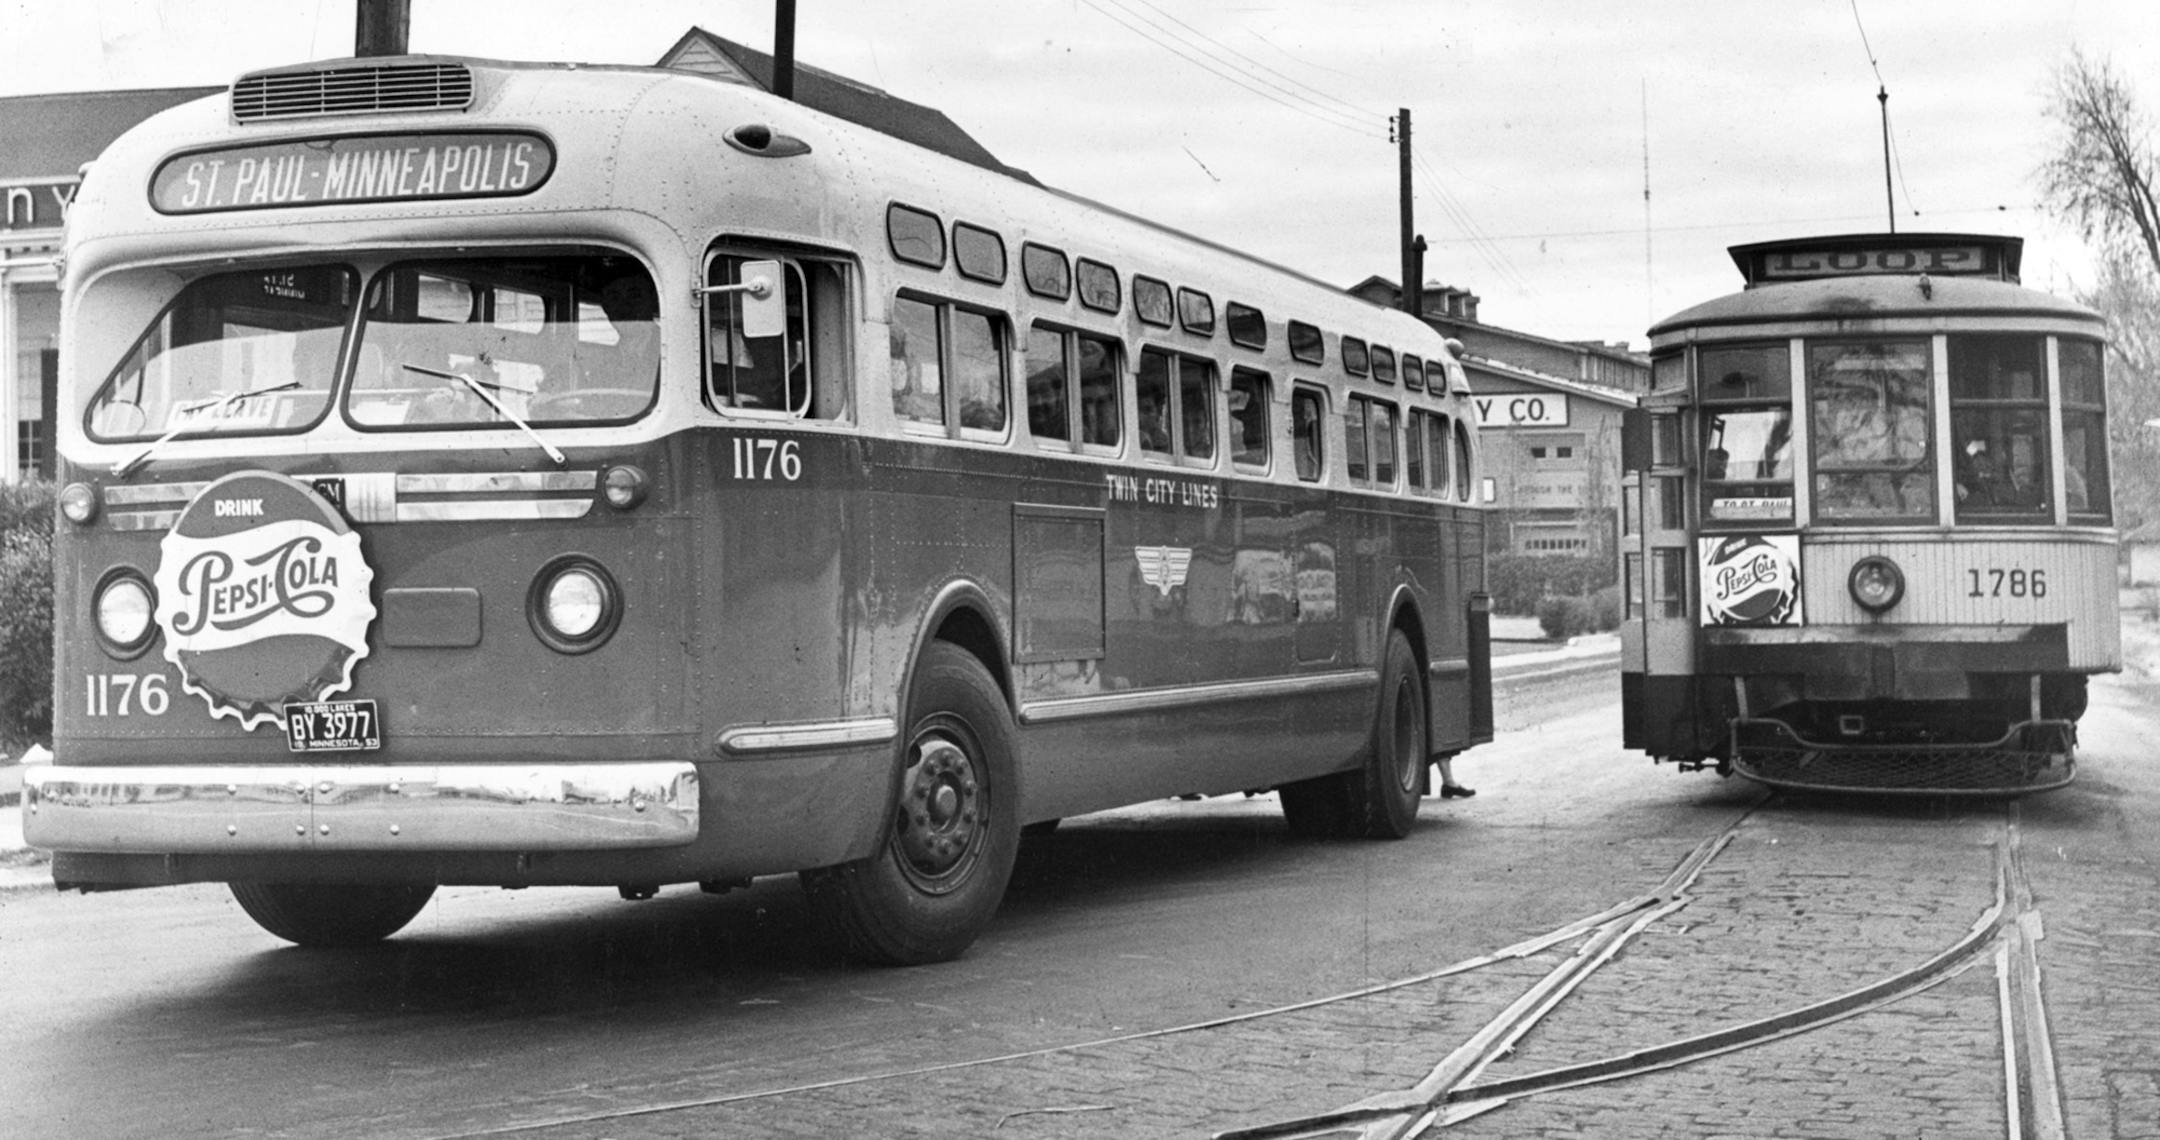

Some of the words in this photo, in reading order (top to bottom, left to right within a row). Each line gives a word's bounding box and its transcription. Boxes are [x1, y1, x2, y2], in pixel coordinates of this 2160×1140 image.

[181, 159, 225, 208] ST.
[1774, 249, 1971, 271] LOOP
[1509, 397, 1550, 422] CO.
[733, 437, 802, 481] 1176
[1106, 474, 1138, 501] TWIN
[1146, 478, 1175, 504] CITY
[1182, 482, 1217, 508] LINES
[214, 499, 264, 517] DRINK
[1968, 568, 2046, 598] 1786
[86, 673, 169, 716] 1176
[291, 713, 315, 740] BY
[321, 710, 370, 739] 3977
[309, 738, 360, 748] MINNESOTA
[366, 738, 378, 746] 53
